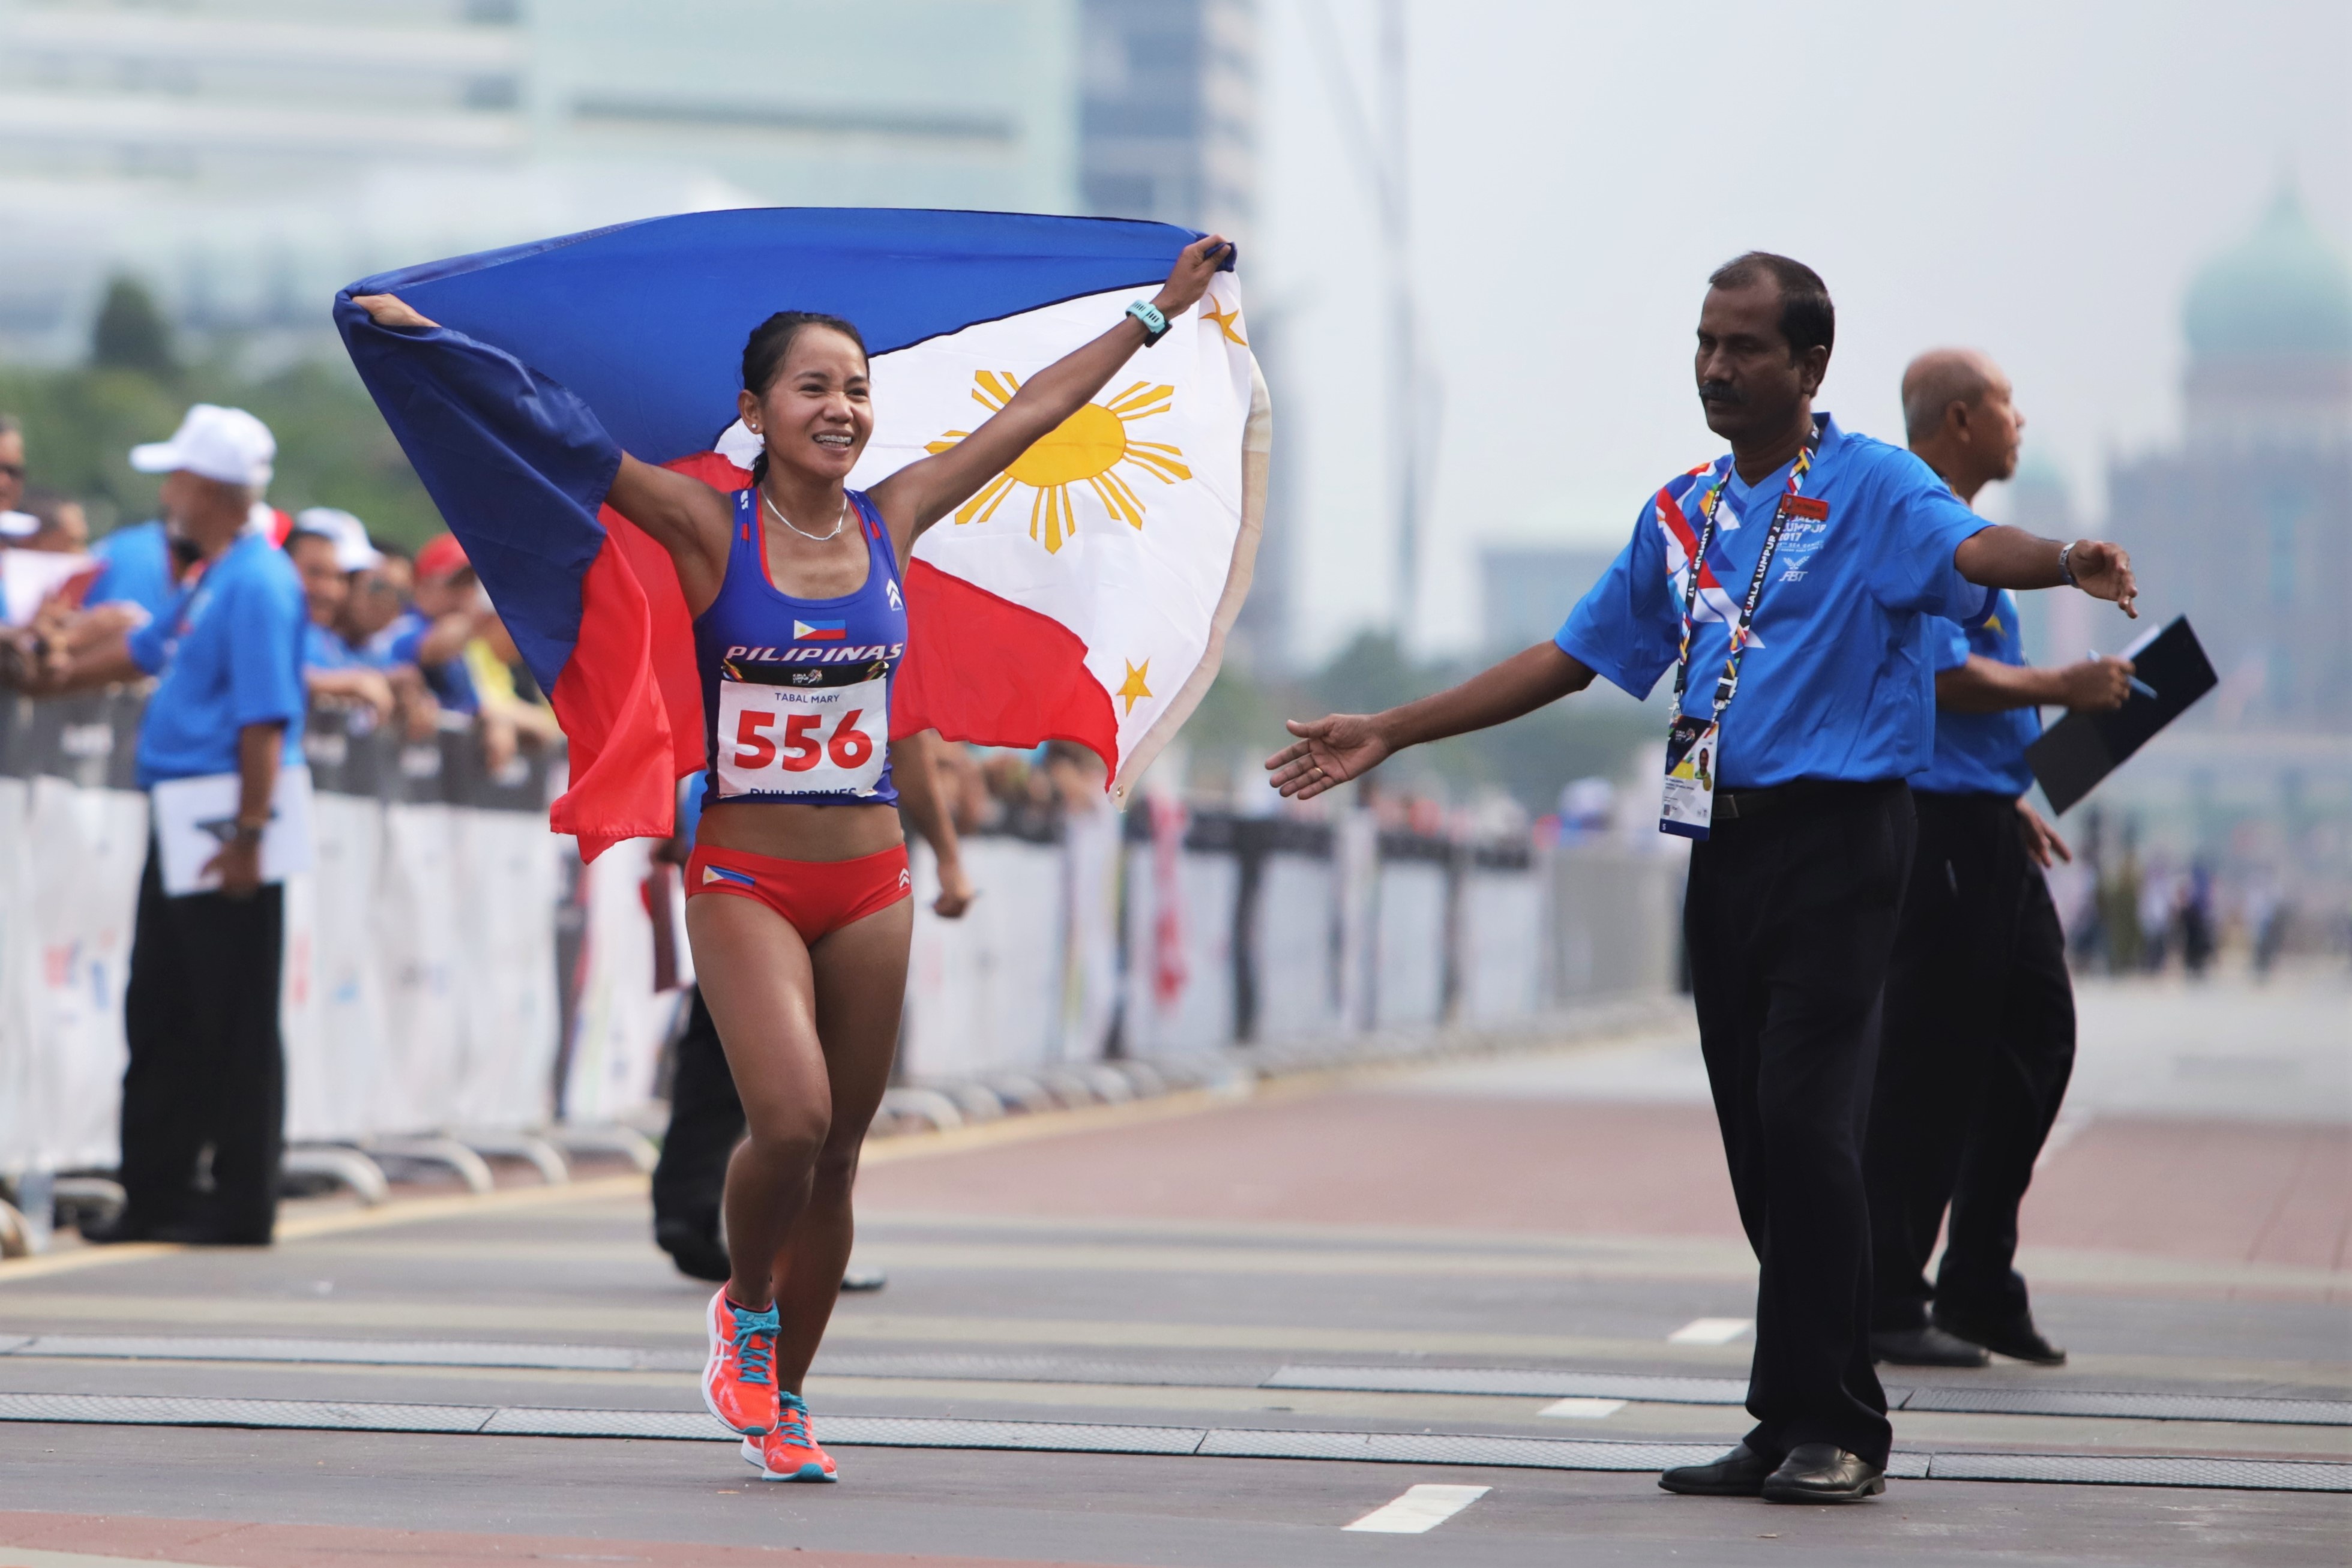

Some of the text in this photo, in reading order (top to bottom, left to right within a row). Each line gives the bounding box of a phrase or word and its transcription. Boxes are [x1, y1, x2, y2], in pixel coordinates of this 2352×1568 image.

[1755, 535, 1776, 579] LUMPUR
[726, 643, 904, 662] PILIPINAS
[775, 692, 840, 704] TABAL MARY
[734, 708, 873, 772] 556
